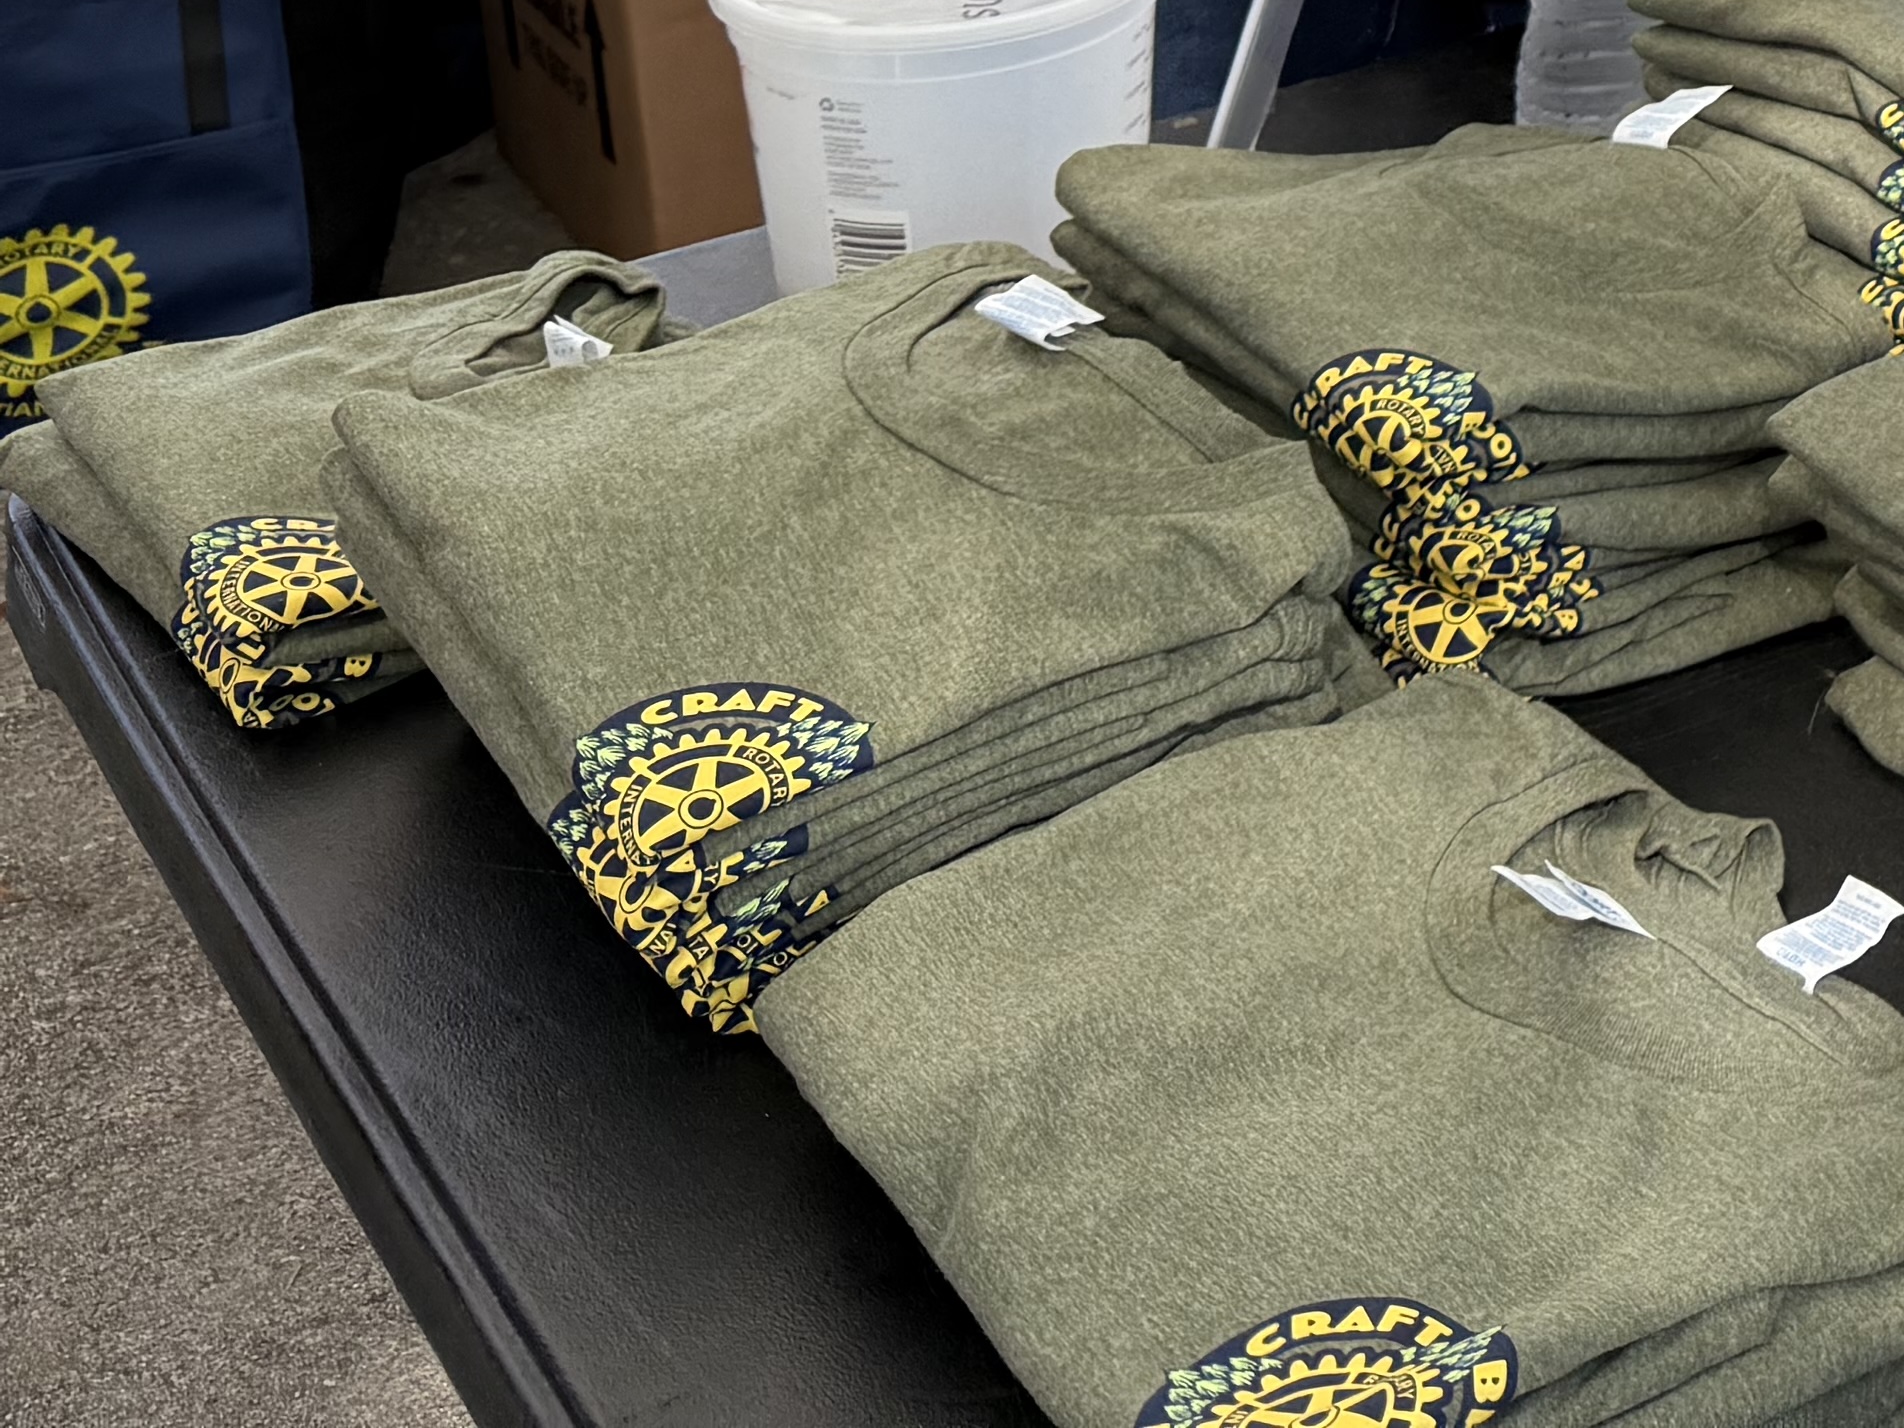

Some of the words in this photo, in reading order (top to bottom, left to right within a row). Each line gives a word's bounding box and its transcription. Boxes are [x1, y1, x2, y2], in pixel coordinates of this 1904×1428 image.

[1315, 352, 1434, 396] RAFT
[1376, 398, 1425, 436] ROTARY
[221, 559, 285, 633] INTERNATION
[640, 688, 824, 726] CRAFT
[1245, 1304, 1454, 1357] CRAFT
